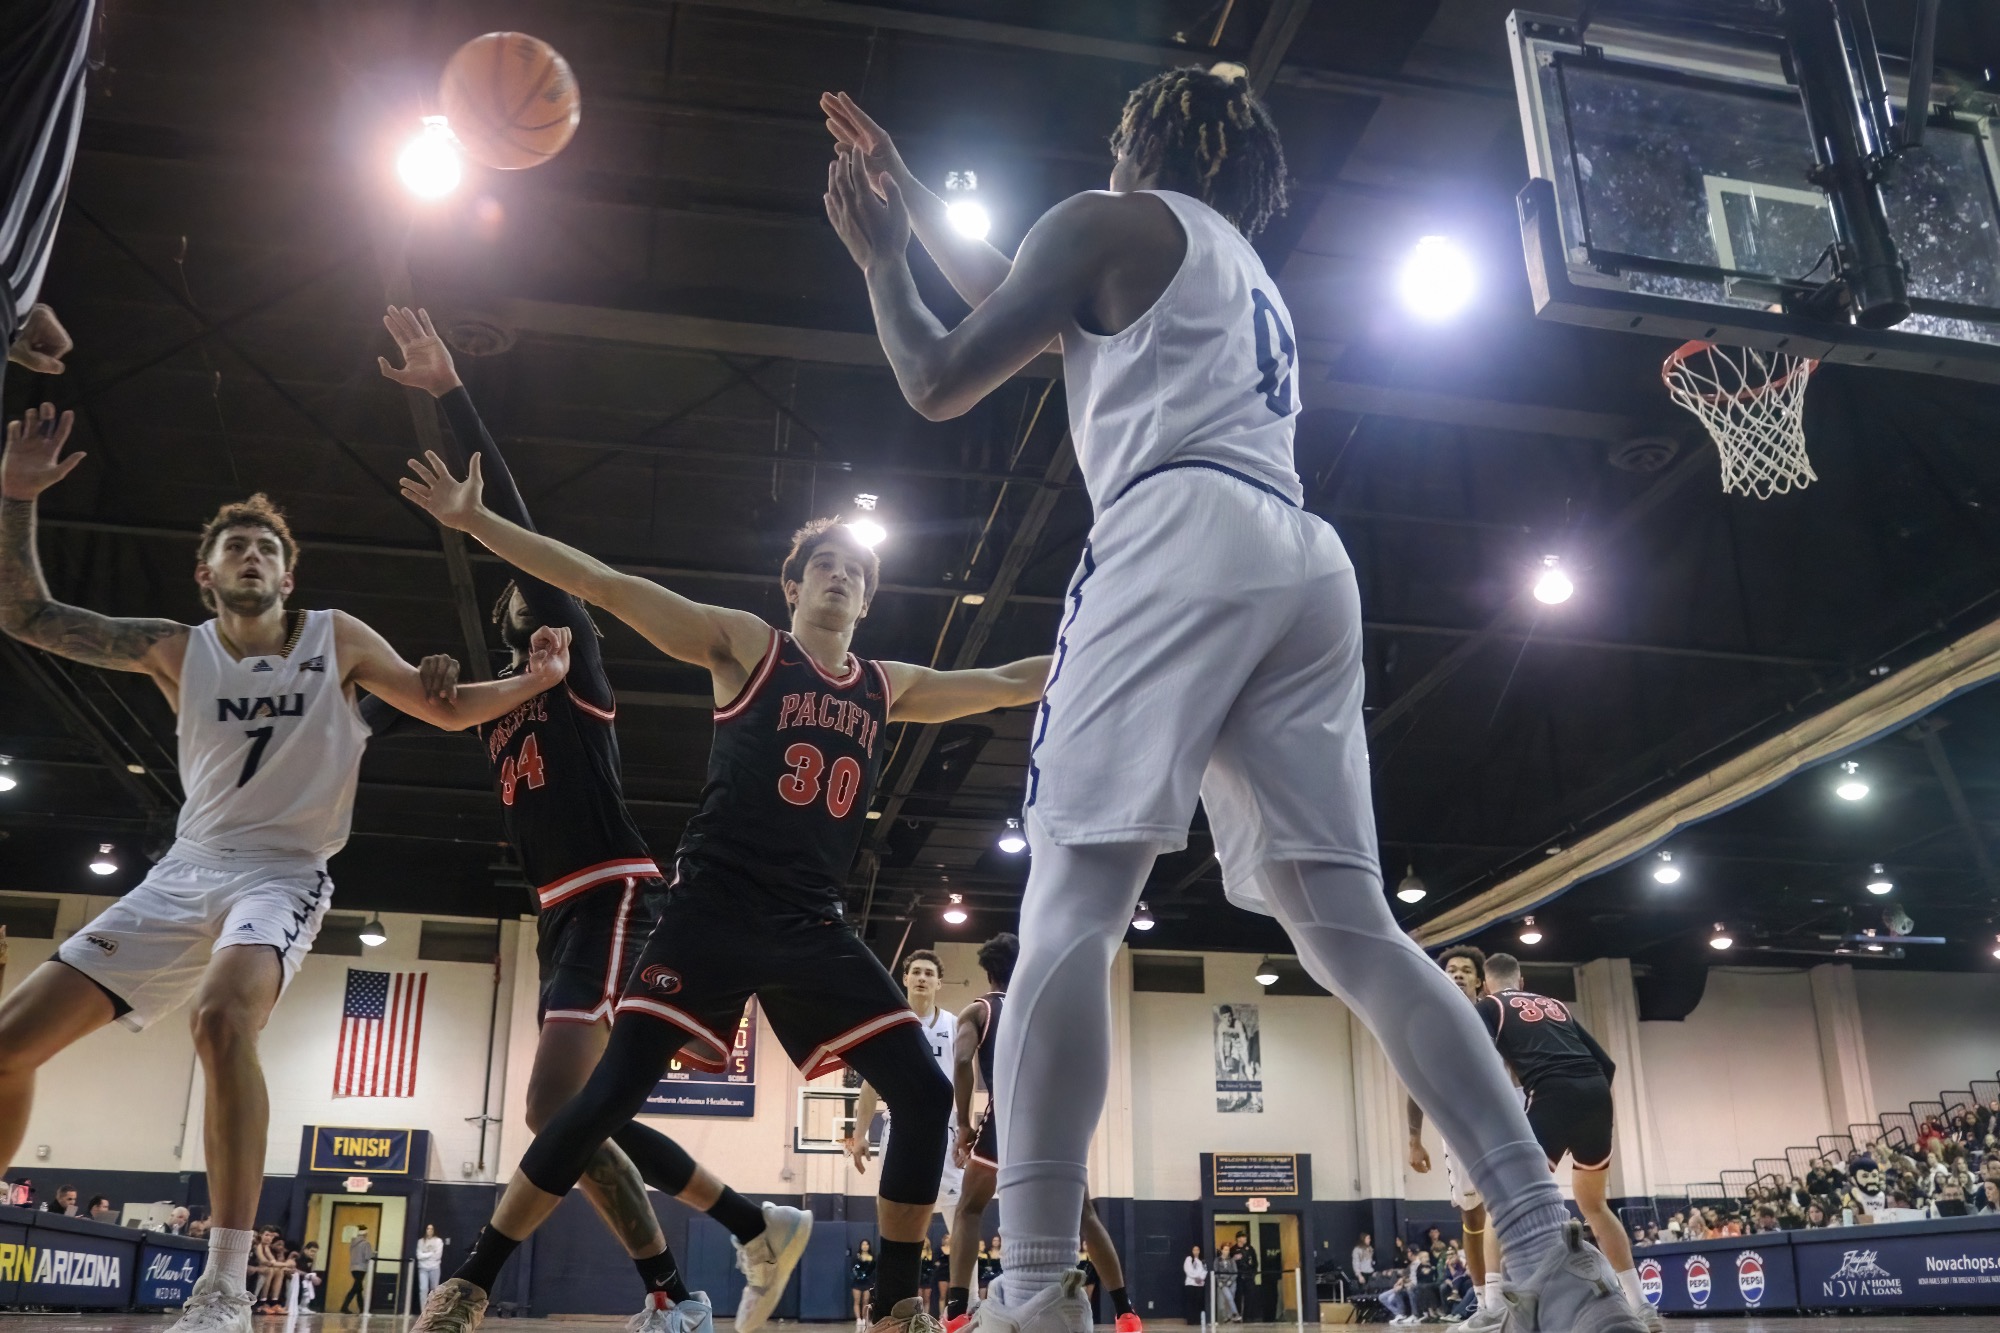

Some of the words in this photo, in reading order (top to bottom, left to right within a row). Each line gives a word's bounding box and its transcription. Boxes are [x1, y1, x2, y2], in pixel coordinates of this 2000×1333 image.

[216, 693, 304, 722] NAU
[777, 691, 878, 759] PACIFIC
[238, 725, 274, 788] 7
[778, 743, 861, 818] 30
[1510, 996, 1567, 1022] 33
[677, 1096, 705, 1105] Arizona
[706, 1097, 745, 1106] Healthcare
[333, 1136, 391, 1158] FINISH
[33, 1248, 121, 1288] ARIZONA
[1642, 1282, 1662, 1291] PEPSI
[1689, 1279, 1710, 1288] PEPSI
[1741, 1276, 1763, 1286] PEPSI
[1871, 1278, 1901, 1288] HOME
[155, 1287, 169, 1299] MED
[169, 1288, 181, 1300] SPA
[1872, 1287, 1903, 1296] LOANS
